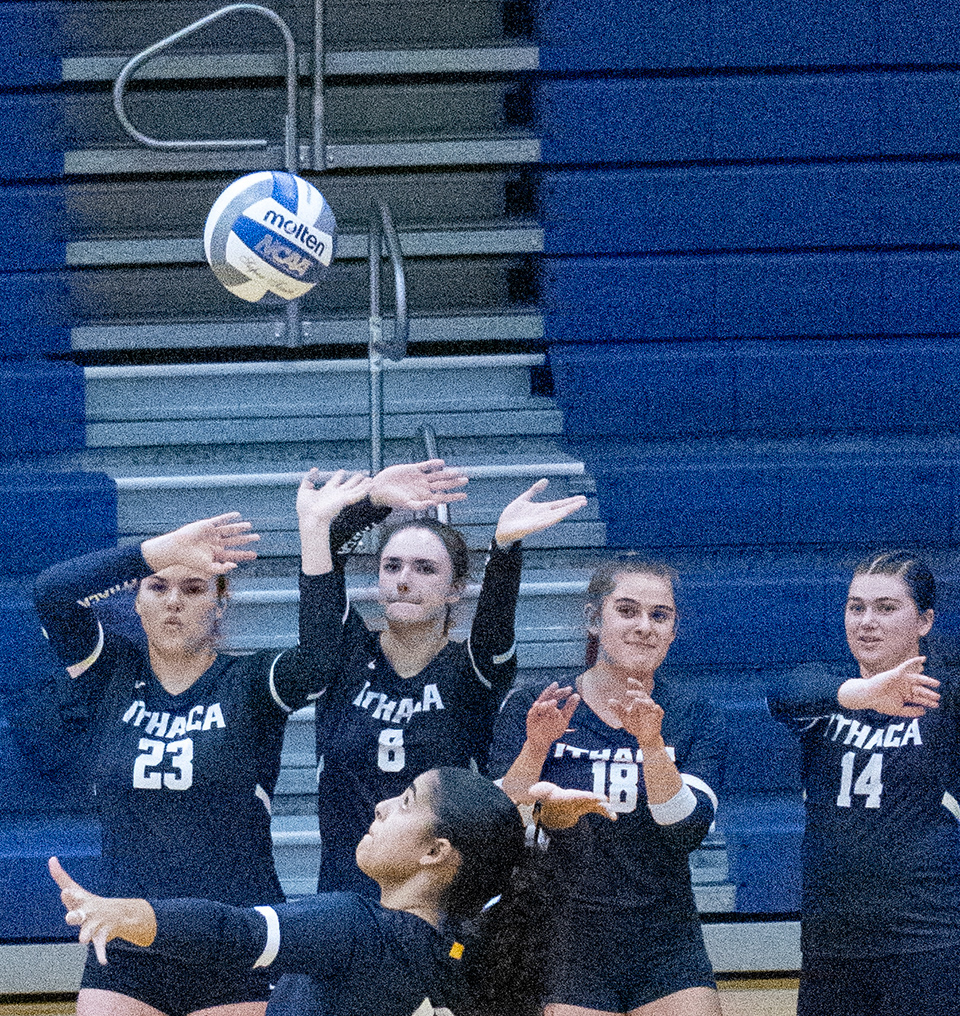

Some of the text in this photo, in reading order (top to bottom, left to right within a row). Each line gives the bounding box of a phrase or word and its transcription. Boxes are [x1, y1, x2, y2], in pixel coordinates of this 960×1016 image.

[254, 234, 313, 275] NCAA
[263, 210, 325, 256] molten
[122, 700, 226, 738] ITHACA
[824, 713, 923, 750] ITHACA
[133, 737, 194, 791] 23
[377, 728, 405, 773] 8
[591, 761, 638, 813] 18
[836, 752, 884, 809] 14
